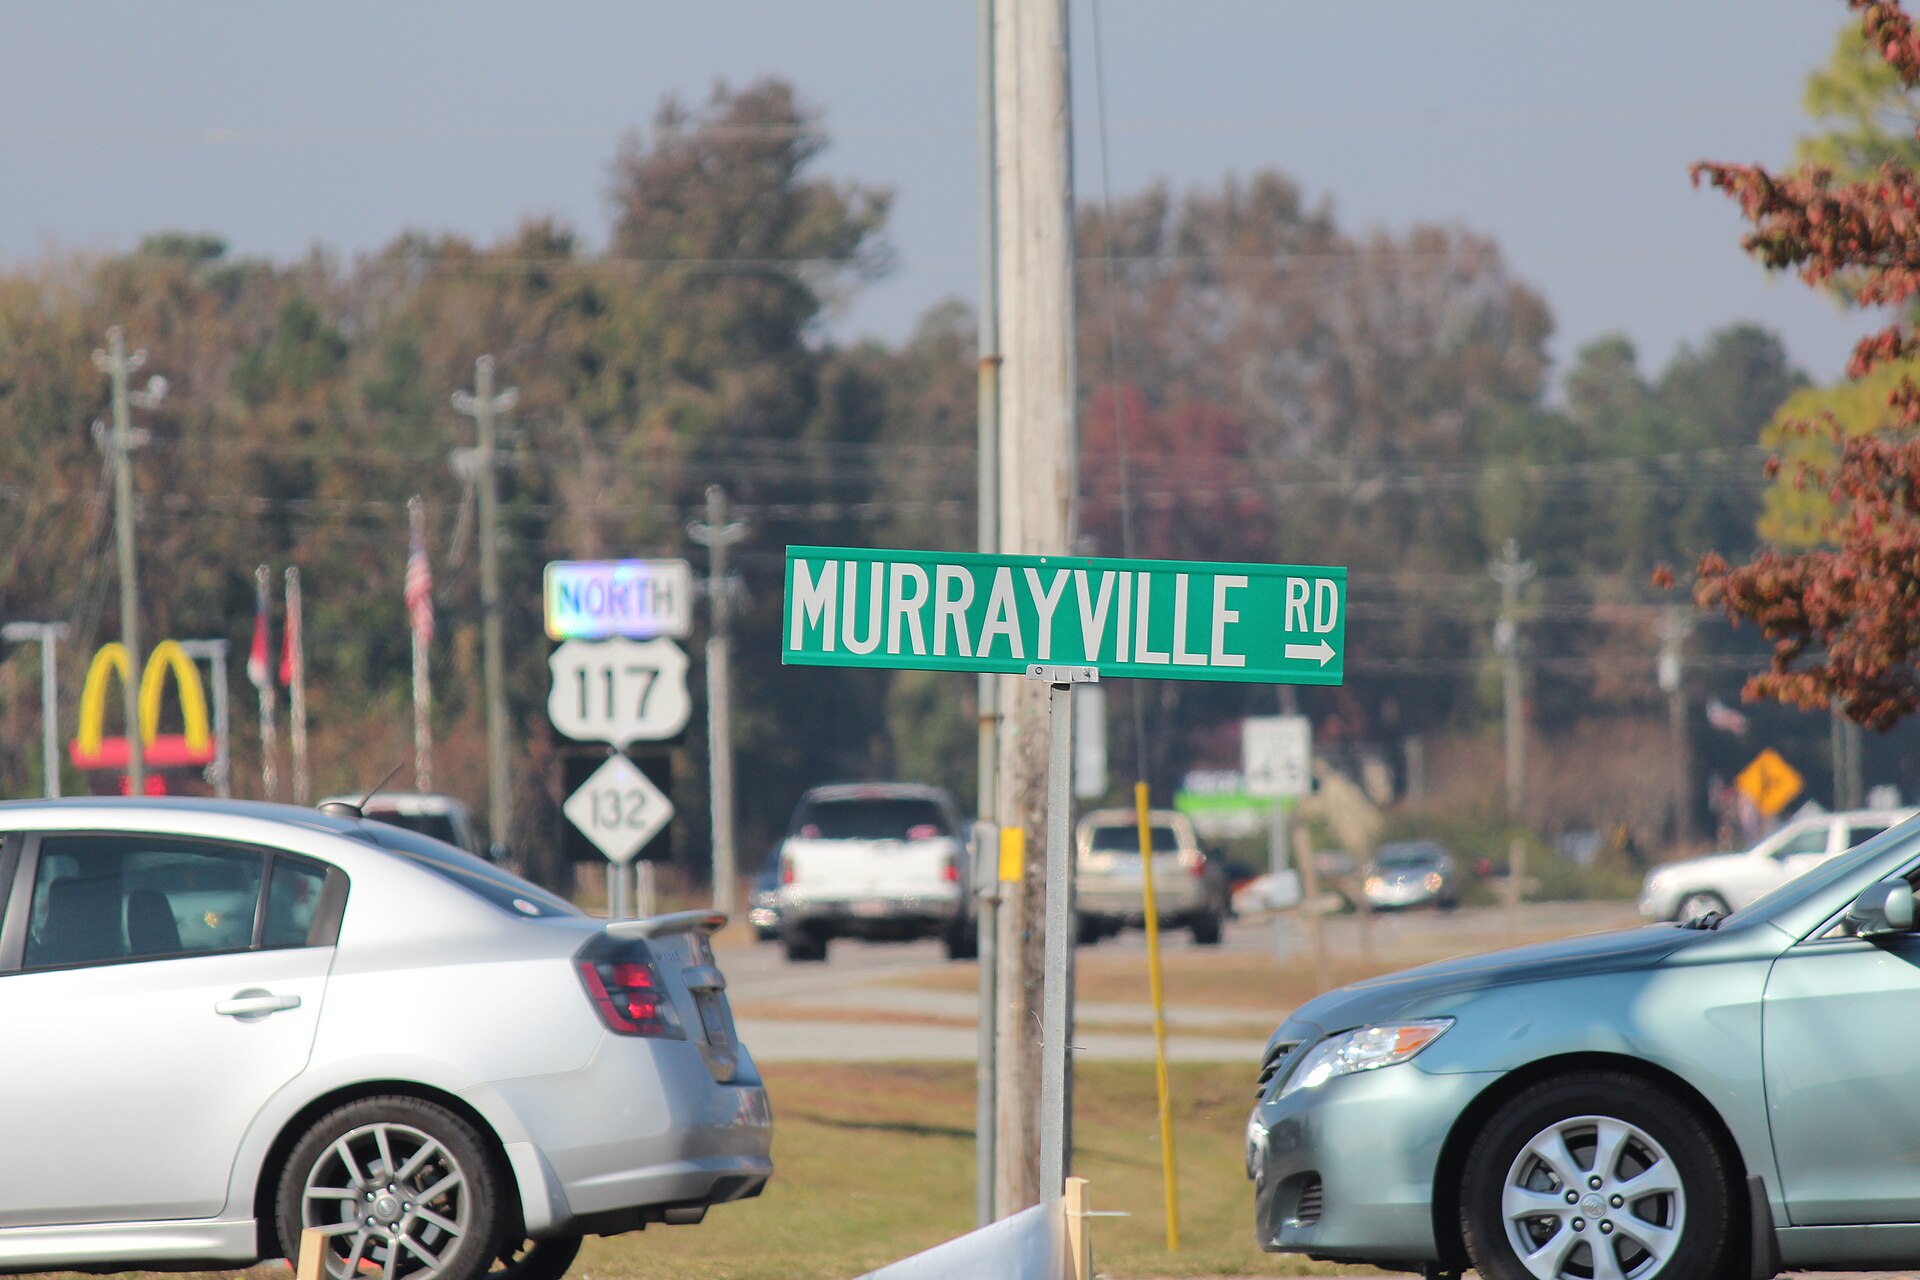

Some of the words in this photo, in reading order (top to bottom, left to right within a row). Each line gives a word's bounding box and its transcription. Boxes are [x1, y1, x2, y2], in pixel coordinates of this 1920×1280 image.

[558, 577, 675, 616] NORTH
[790, 558, 1248, 667] MURRAYVILLE
[1284, 577, 1339, 633] RD
[574, 665, 662, 721] 117
[590, 788, 647, 830] 132
